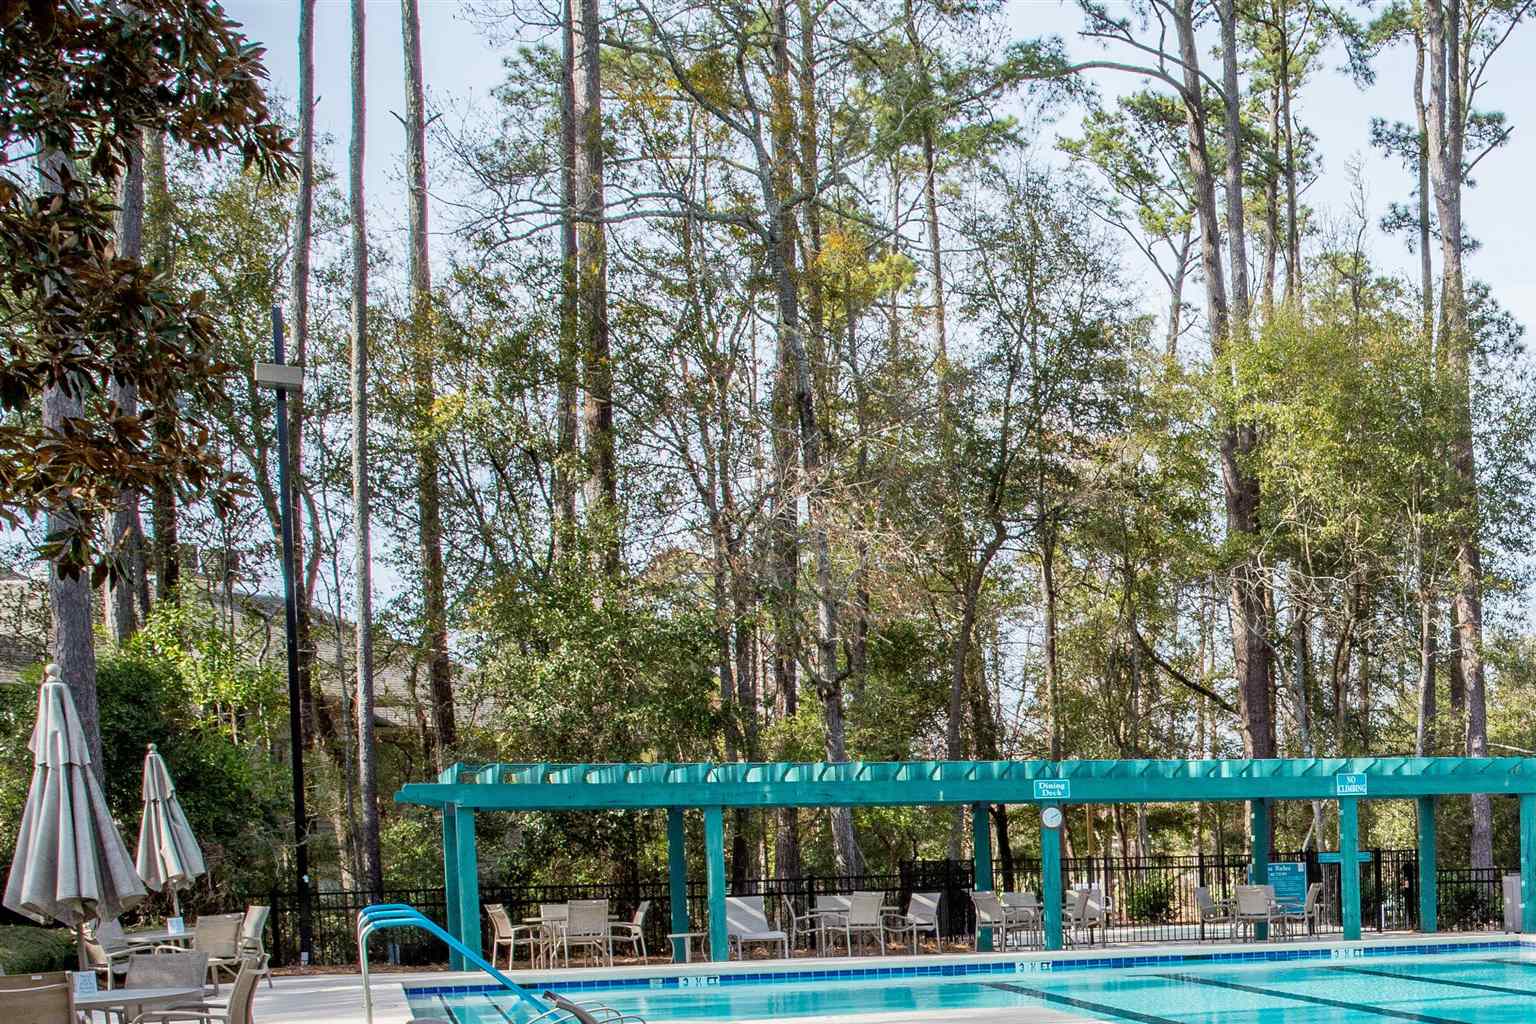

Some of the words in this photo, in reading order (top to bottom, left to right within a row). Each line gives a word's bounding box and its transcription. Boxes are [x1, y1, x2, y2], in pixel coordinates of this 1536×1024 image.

[1346, 775, 1357, 784] NO
[1039, 782, 1065, 790] Dining
[1042, 789, 1063, 797] Deck
